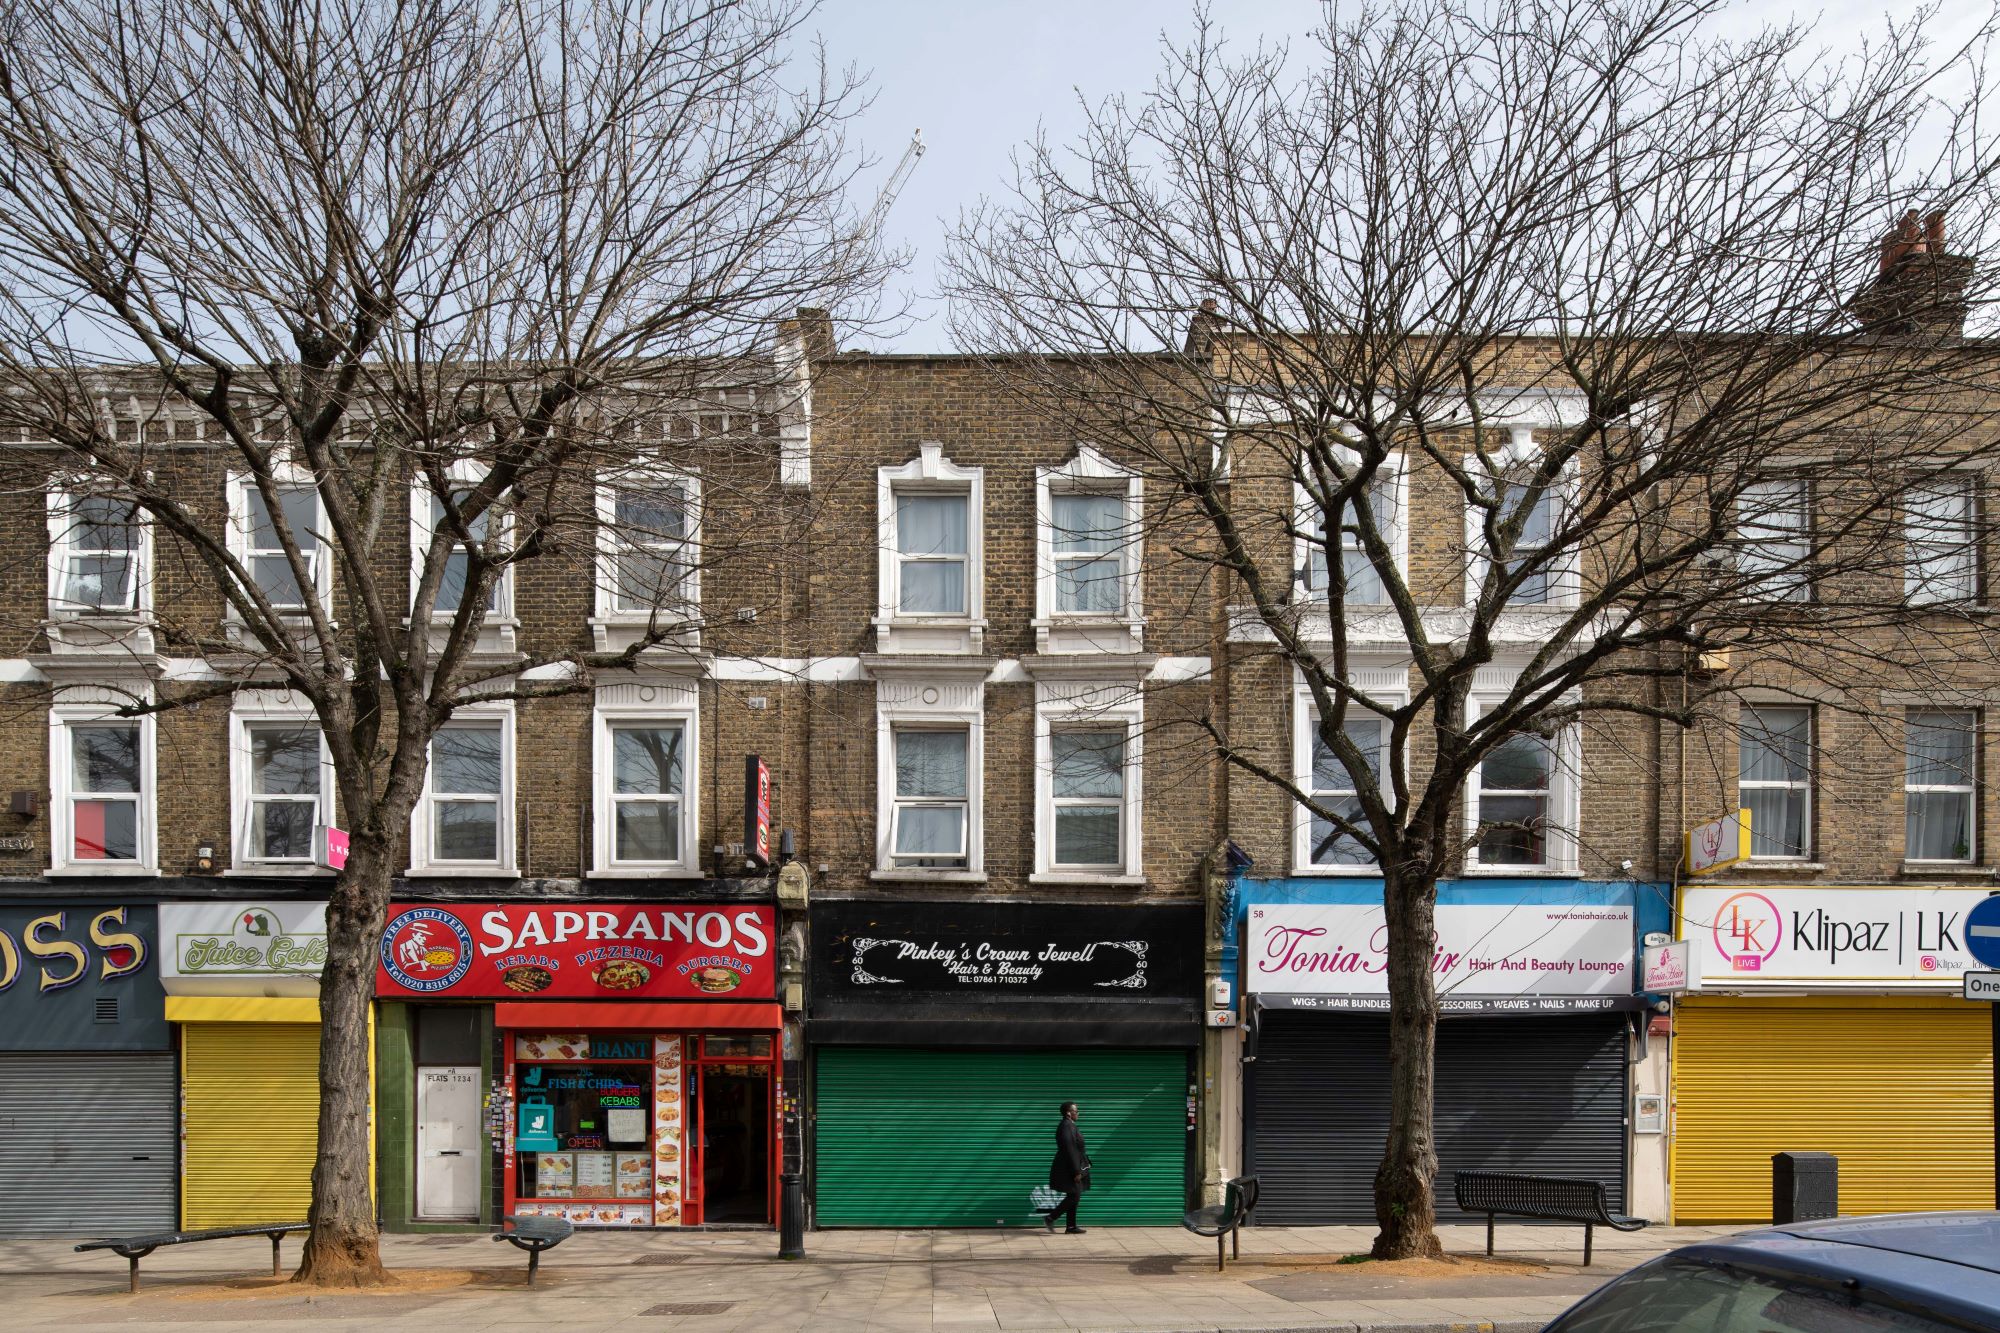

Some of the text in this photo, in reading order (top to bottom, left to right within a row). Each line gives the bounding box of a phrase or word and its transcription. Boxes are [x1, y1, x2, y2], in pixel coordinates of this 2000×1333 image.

[1253, 910, 1264, 918] 58
[1547, 911, 1629, 920] www.toniahair.co.uk
[385, 910, 469, 940] FREE DELIVERY
[1729, 904, 1768, 952] LK
[479, 910, 768, 957] SAPRANOS
[1793, 908, 1959, 965] Klipaz LK
[185, 937, 263, 969] Juice
[897, 942, 1097, 967] Pinkey's Crown Jewell
[1259, 925, 1363, 973] Tonia
[495, 955, 560, 970] KEBABS
[575, 946, 664, 968] PIZZERIA
[852, 957, 863, 965] 60
[1737, 959, 1756, 967] LIVE
[678, 956, 753, 975] BURGERS
[948, 961, 1043, 980] Hair & Beauty
[1469, 958, 1625, 974] Hair And Beauty Lounge
[425, 980, 448, 990] 8316
[448, 962, 467, 982] 6615
[998, 976, 1027, 984] 710372
[1971, 979, 2000, 992] One
[1291, 998, 1317, 1006] WIGS
[1327, 999, 1348, 1007] HAIR
[1351, 1000, 1391, 1008] BUNDLES
[1494, 1000, 1529, 1009] WEAVES
[1539, 1000, 1565, 1008] NAILS
[1575, 1000, 1600, 1008] MAKE
[1602, 1000, 1615, 1008] UP
[548, 1079, 578, 1089] FISH
[588, 1079, 624, 1089] CHIPS
[600, 1088, 640, 1096] BURGERS
[600, 1096, 640, 1106] KEBABS
[568, 1138, 601, 1147] OPEN
